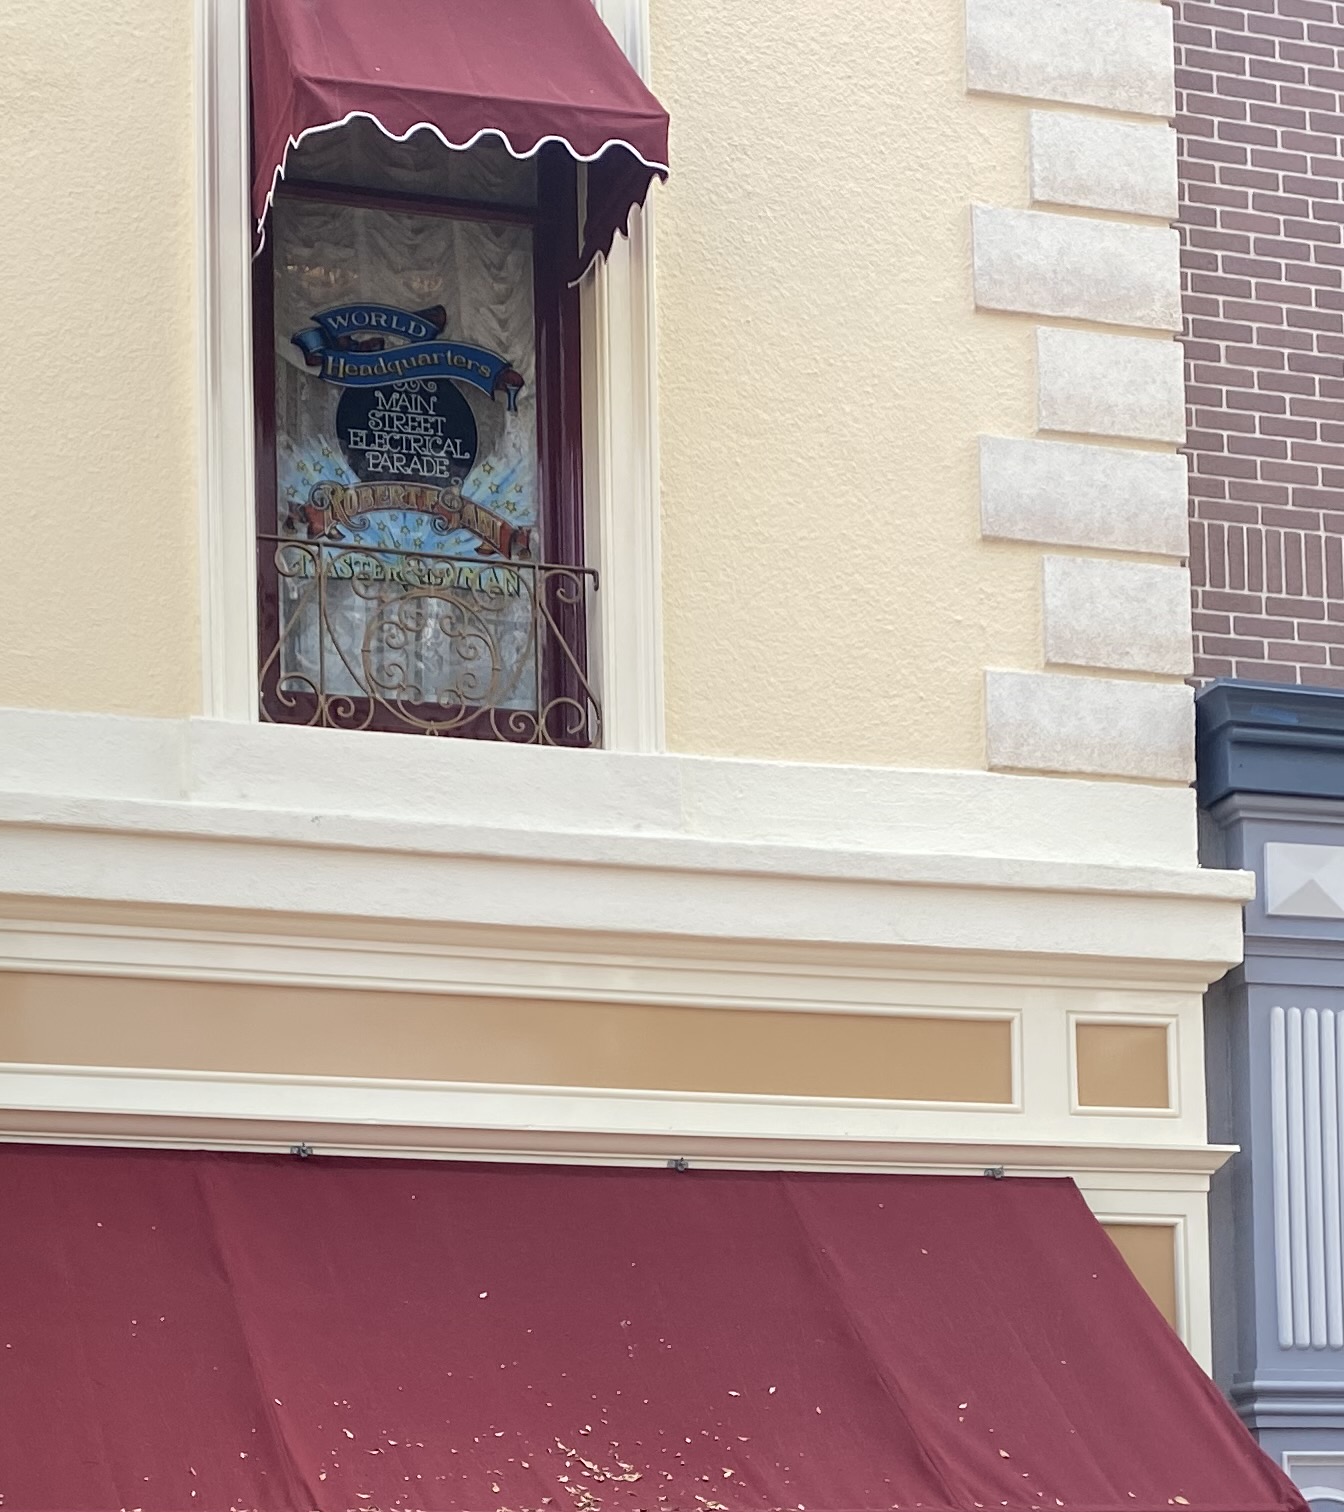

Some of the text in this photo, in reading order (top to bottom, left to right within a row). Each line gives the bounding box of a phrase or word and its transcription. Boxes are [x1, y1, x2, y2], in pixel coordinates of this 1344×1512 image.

[327, 311, 427, 339] WORLD
[326, 350, 492, 379] Headquarters
[374, 390, 438, 415] MAIN
[367, 409, 447, 436] STREET
[347, 428, 471, 459] ELECTRICAL
[365, 451, 450, 478] PARADE
